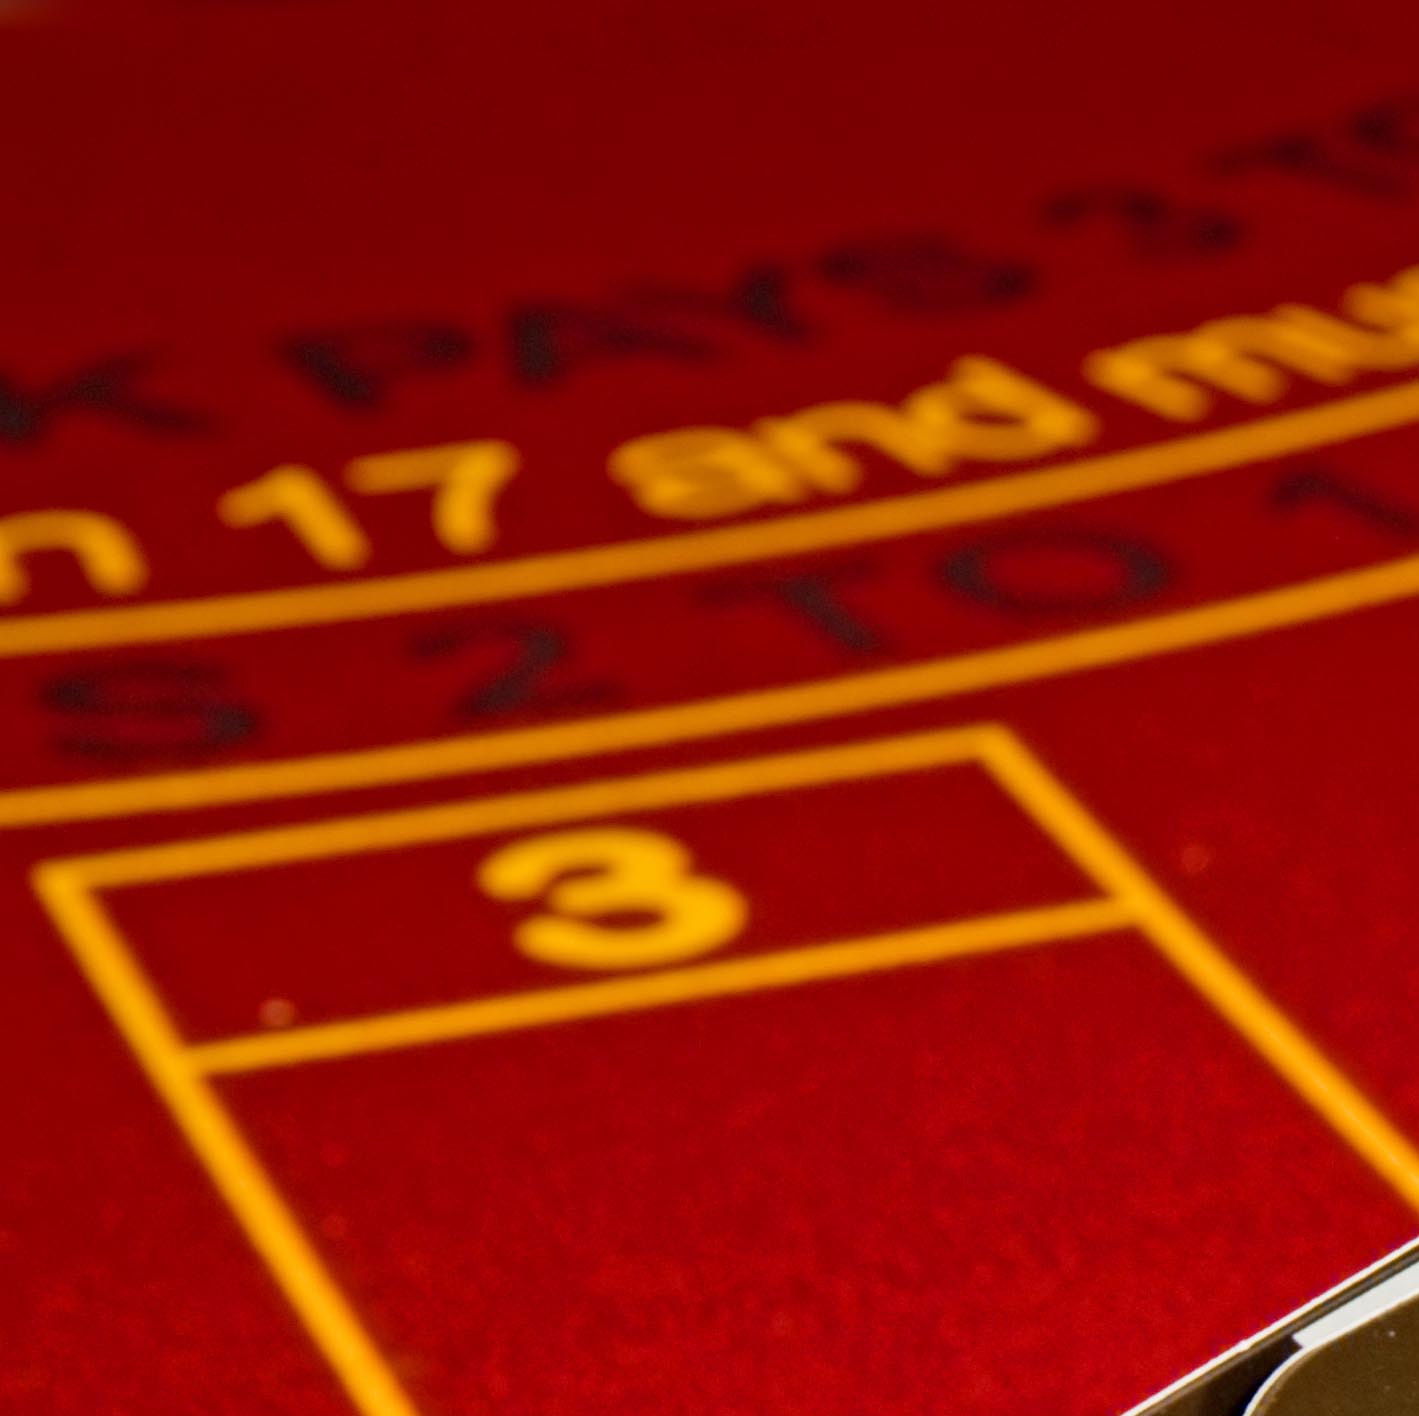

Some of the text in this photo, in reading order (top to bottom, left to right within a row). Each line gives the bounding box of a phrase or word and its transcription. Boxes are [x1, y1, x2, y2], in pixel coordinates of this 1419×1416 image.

[268, 230, 1038, 412] PAYS
[219, 437, 523, 572] 17
[607, 353, 1098, 520] and
[408, 616, 632, 720] 2
[698, 524, 1174, 657] TO
[476, 825, 750, 972] 3
